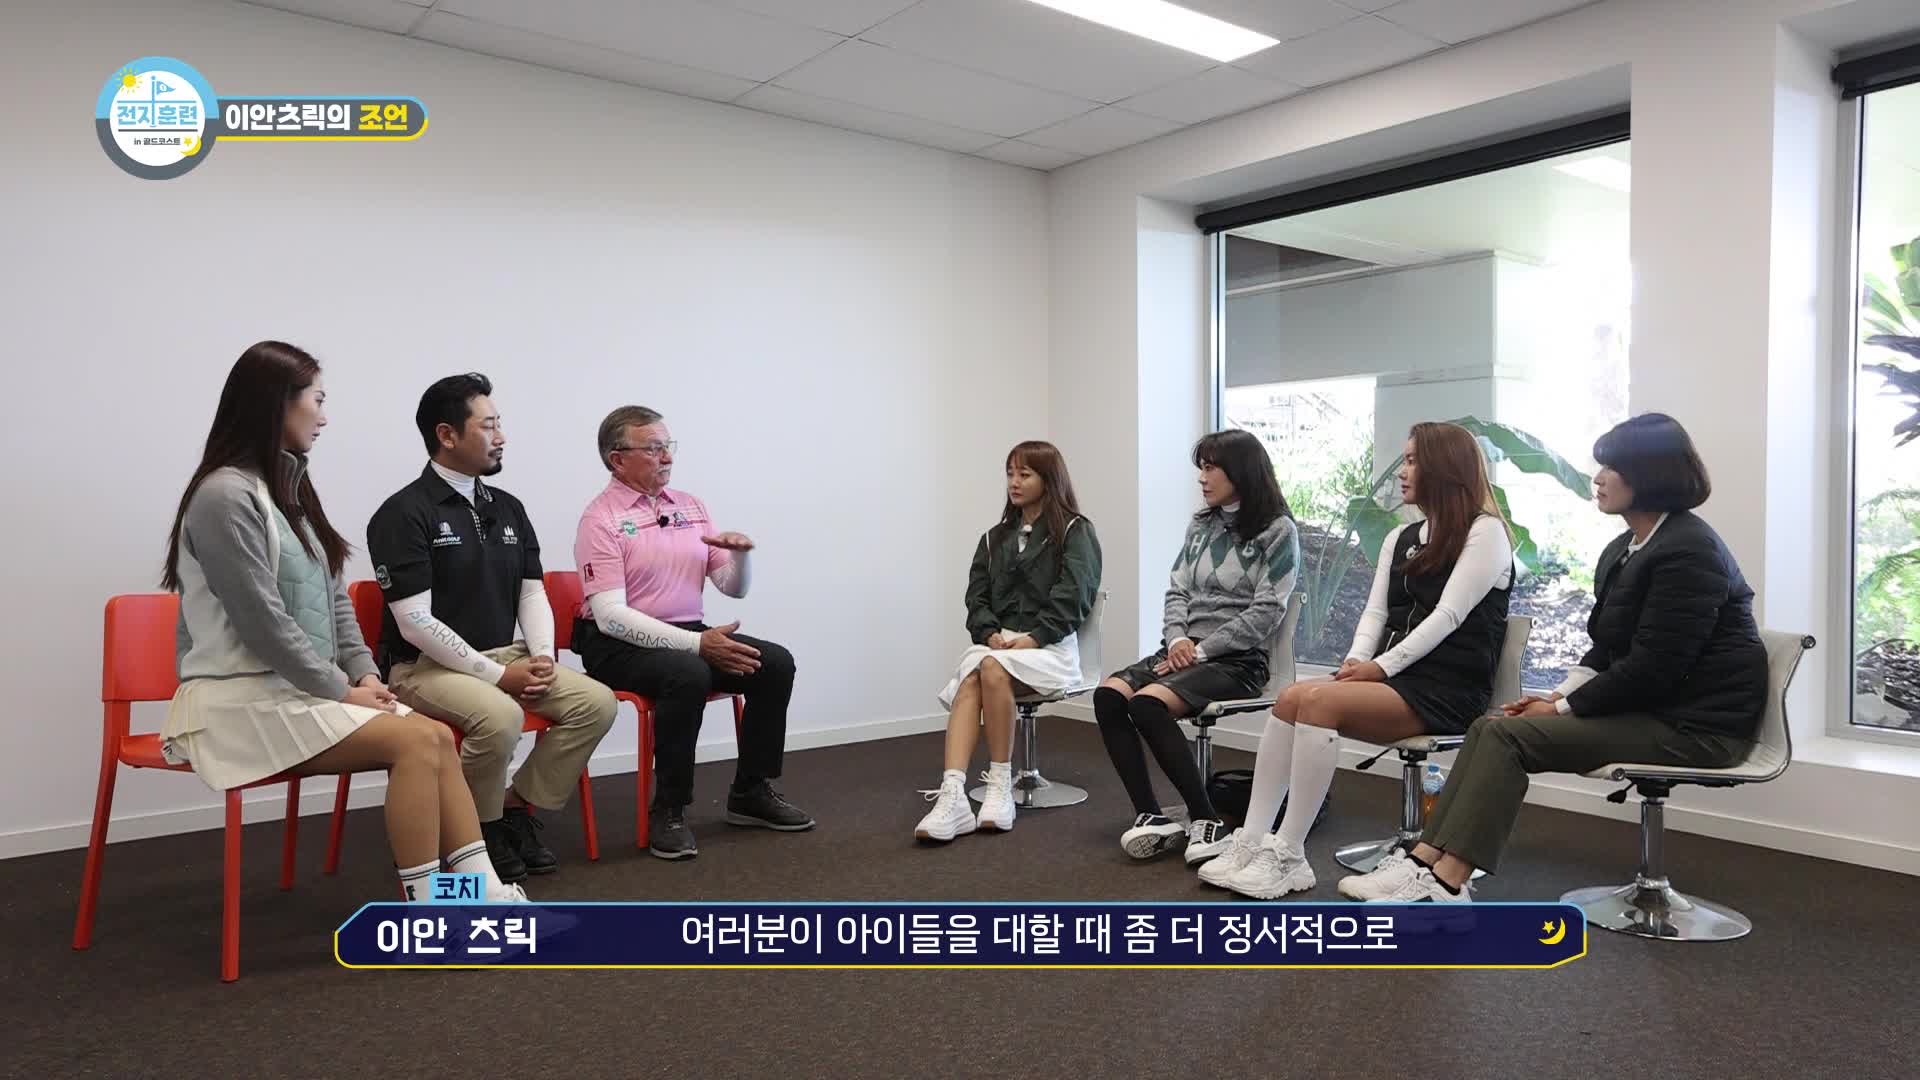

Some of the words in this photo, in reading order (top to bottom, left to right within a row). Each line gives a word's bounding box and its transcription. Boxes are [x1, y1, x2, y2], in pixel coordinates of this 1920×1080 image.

[1189, 534, 1204, 555] H
[409, 608, 471, 659] SPARMS
[606, 619, 671, 650] SPARMS
